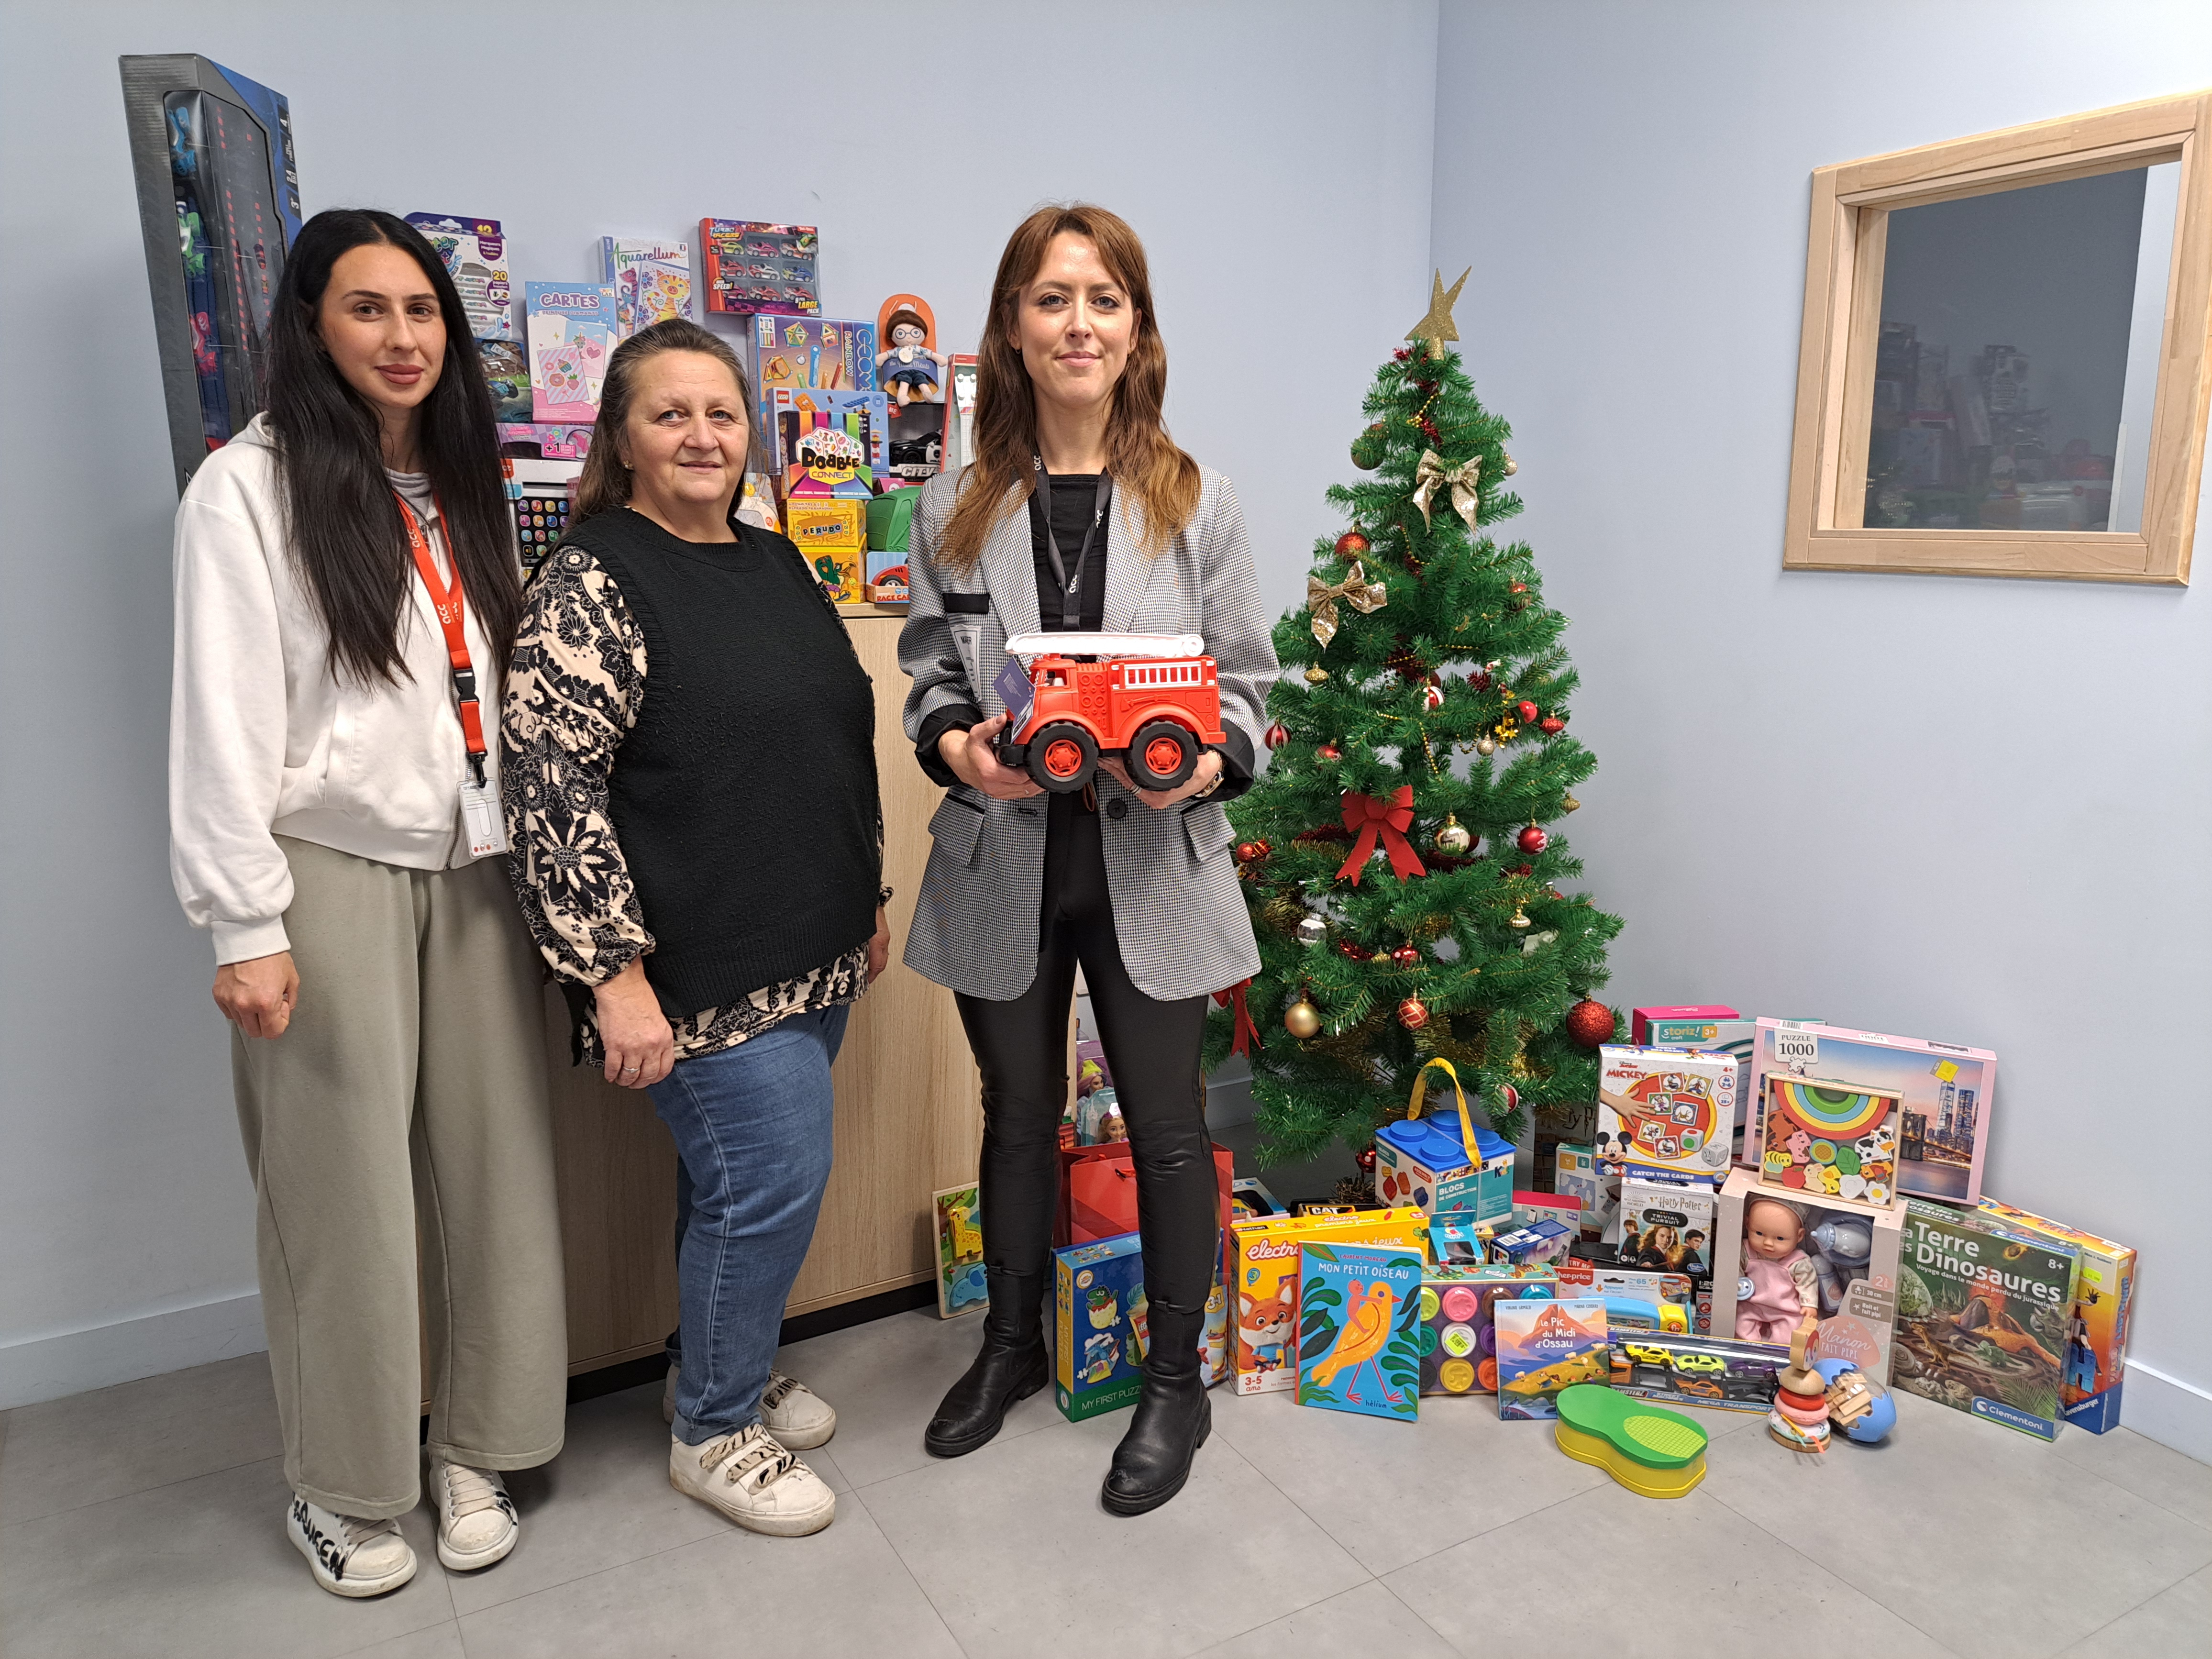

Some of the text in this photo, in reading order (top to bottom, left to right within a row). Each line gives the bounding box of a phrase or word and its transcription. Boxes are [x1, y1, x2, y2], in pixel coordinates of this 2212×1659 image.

[607, 242, 686, 270] Aquarellum
[492, 270, 508, 281] 20
[540, 293, 599, 309] CARTES
[798, 301, 818, 309] LARGE
[844, 331, 854, 377] RAINBOW
[802, 447, 860, 470] DOBBLE
[811, 471, 852, 479] CONNECT
[901, 466, 937, 477] CITY
[803, 525, 841, 535] PERUDO
[1778, 1043, 1814, 1056] 1000
[1606, 1069, 1648, 1080] MICKEY
[1438, 1182, 1465, 1195] BLOCS
[1445, 1186, 1477, 1200] CONSTRUCTION
[1658, 1196, 1702, 1212] Harry Potter
[1311, 1206, 1339, 1215] CAT
[1907, 1205, 1960, 1221] osaures
[1650, 1217, 1680, 1225] PURSUIT
[1914, 1220, 1980, 1258] Terre
[1318, 1262, 1339, 1273] MON
[2047, 1258, 2064, 1270] 8+
[1249, 1270, 1257, 1280] 3
[1558, 1270, 1591, 1281] her-price
[1916, 1242, 2061, 1303] Dinosaures
[1875, 1276, 1883, 1287] 2
[1916, 1263, 2060, 1311] Voyage dans le monde perdu du jurassique
[1138, 1321, 1148, 1333] LEG
[1550, 1316, 1565, 1327] Pic
[1542, 1327, 1576, 1338] du Midi
[1817, 1322, 1871, 1350] Manon
[1535, 1339, 1574, 1349] d'Ossau
[1821, 1342, 1858, 1360] FAIT PIPI
[1245, 1376, 1262, 1386] 3-5
[1082, 1384, 1142, 1411] MY FIRST PUZZ
[1723, 1402, 1774, 1412] TRANSPORT
[1988, 1405, 2043, 1431] Clementoni
